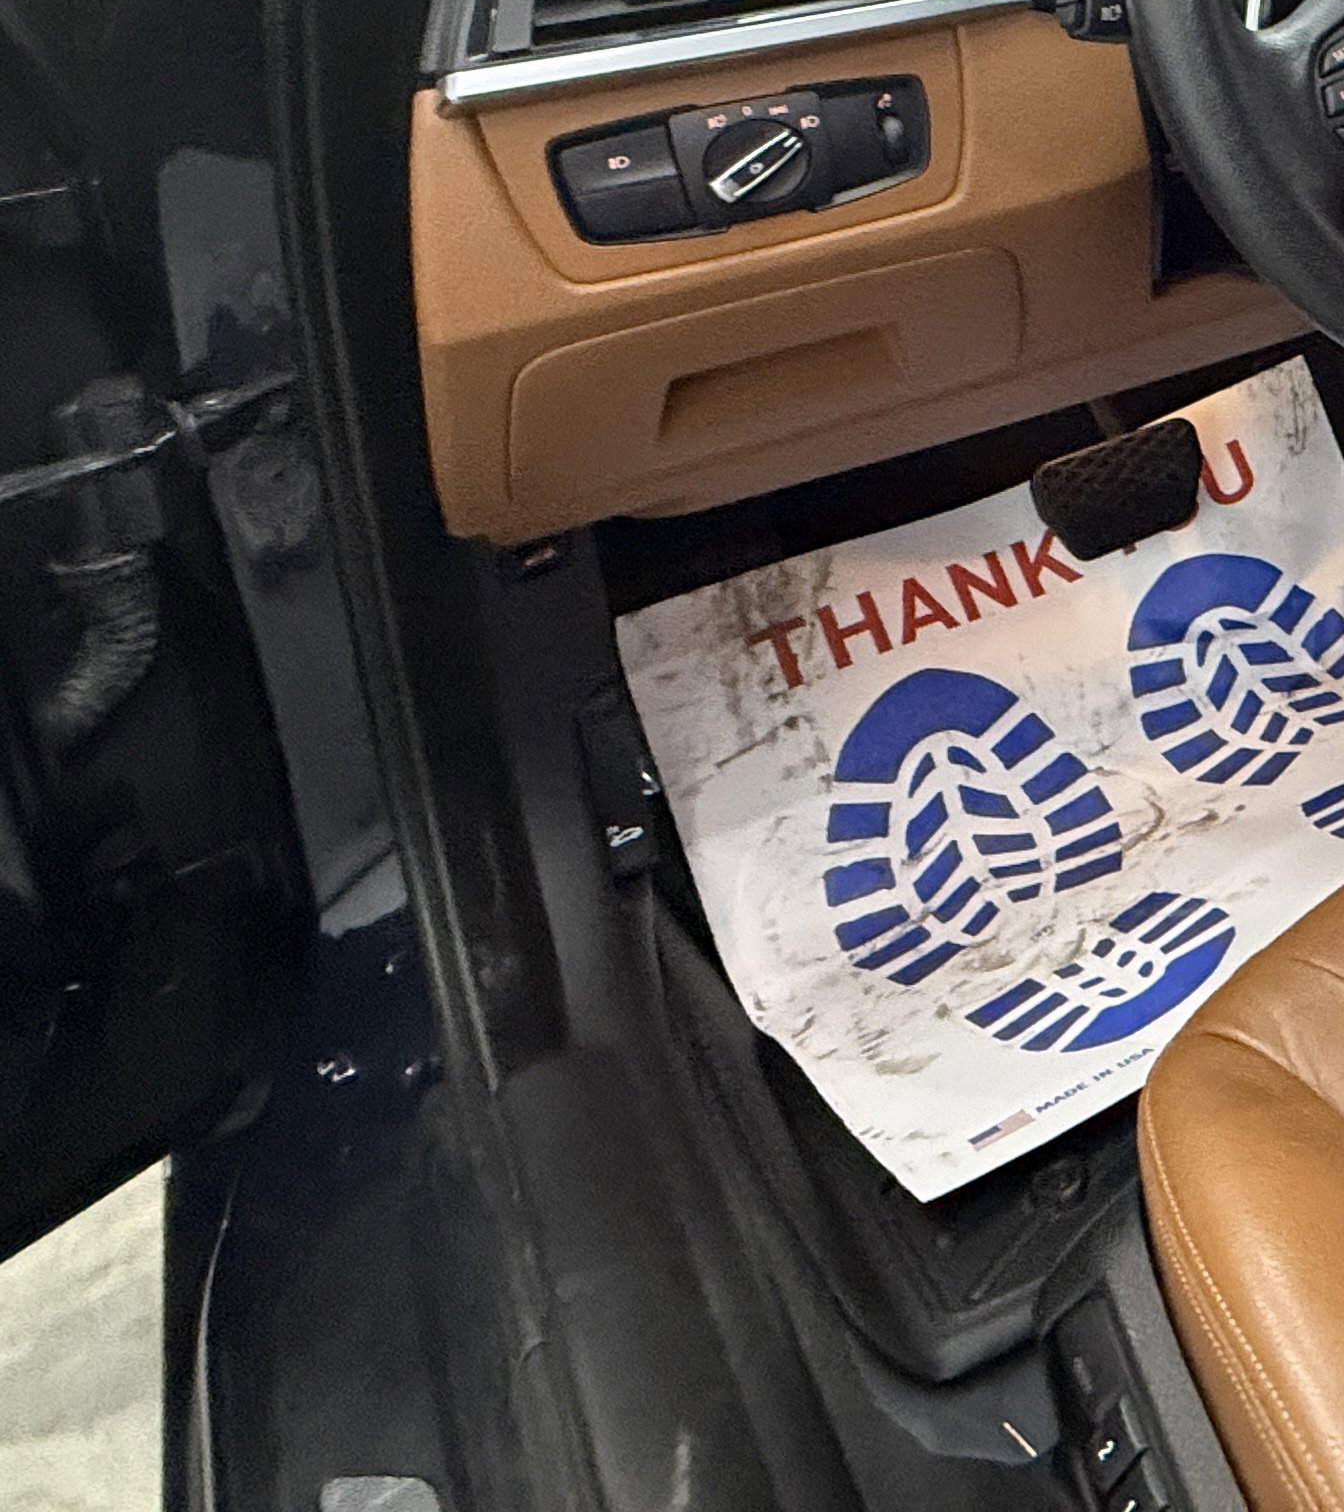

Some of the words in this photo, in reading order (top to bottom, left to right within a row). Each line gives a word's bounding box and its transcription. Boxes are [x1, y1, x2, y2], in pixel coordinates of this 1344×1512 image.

[744, 528, 1084, 690] THANK
[1035, 1082, 1089, 1114] MADE
[1092, 1069, 1113, 1082] IN
[1116, 1047, 1155, 1069] USA
